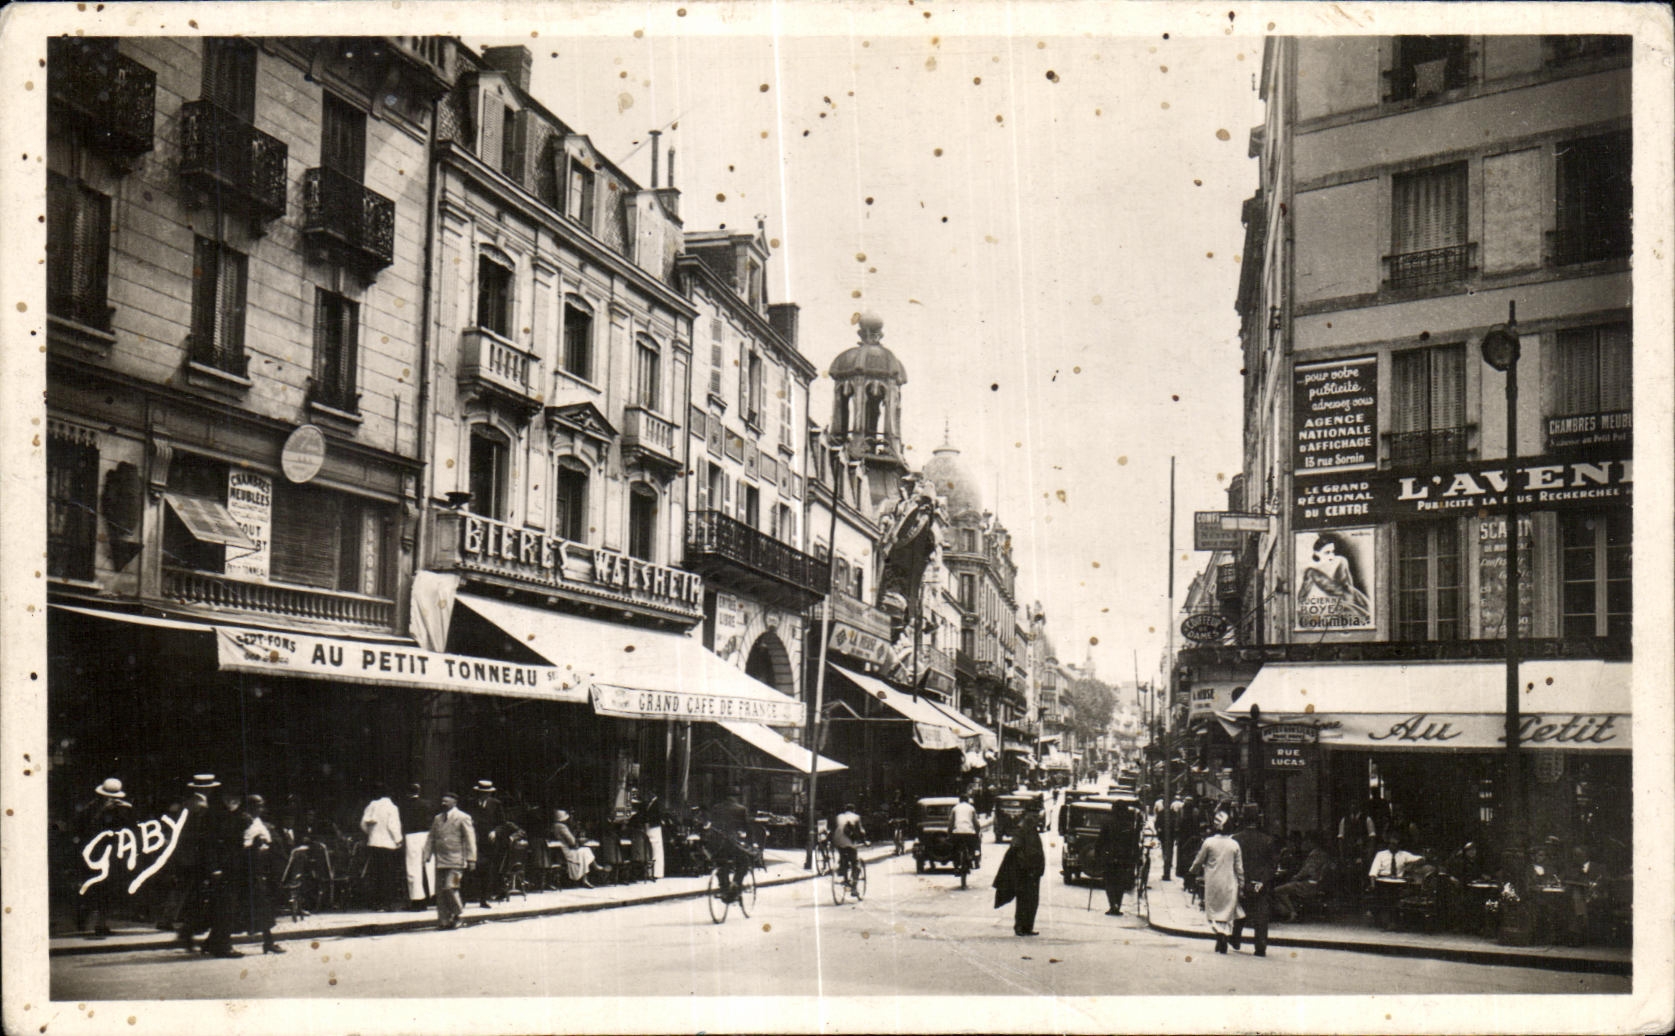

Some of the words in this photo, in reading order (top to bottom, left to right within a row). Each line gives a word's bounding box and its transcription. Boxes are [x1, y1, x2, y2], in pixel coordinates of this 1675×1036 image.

[1304, 413, 1365, 428] AGENCE
[1549, 416, 1596, 435] CHAMBRES
[1298, 425, 1372, 440] NATIONALE
[1305, 457, 1315, 468] 13
[1317, 456, 1333, 467] rue
[1304, 486, 1319, 495] LE
[1322, 481, 1369, 493] GRAND
[1297, 491, 1374, 506] RÉGIONAL
[1305, 508, 1319, 518] DU
[1324, 503, 1369, 516] CENTRE
[311, 643, 344, 667] AU
[362, 649, 429, 675] PETIT
[444, 658, 537, 687] TONNEAU
[638, 693, 680, 713] GRAND
[719, 699, 733, 716] DE
[738, 700, 777, 719] FRANCE
[1367, 711, 1463, 741] Au
[1271, 758, 1306, 766] LUCAS
